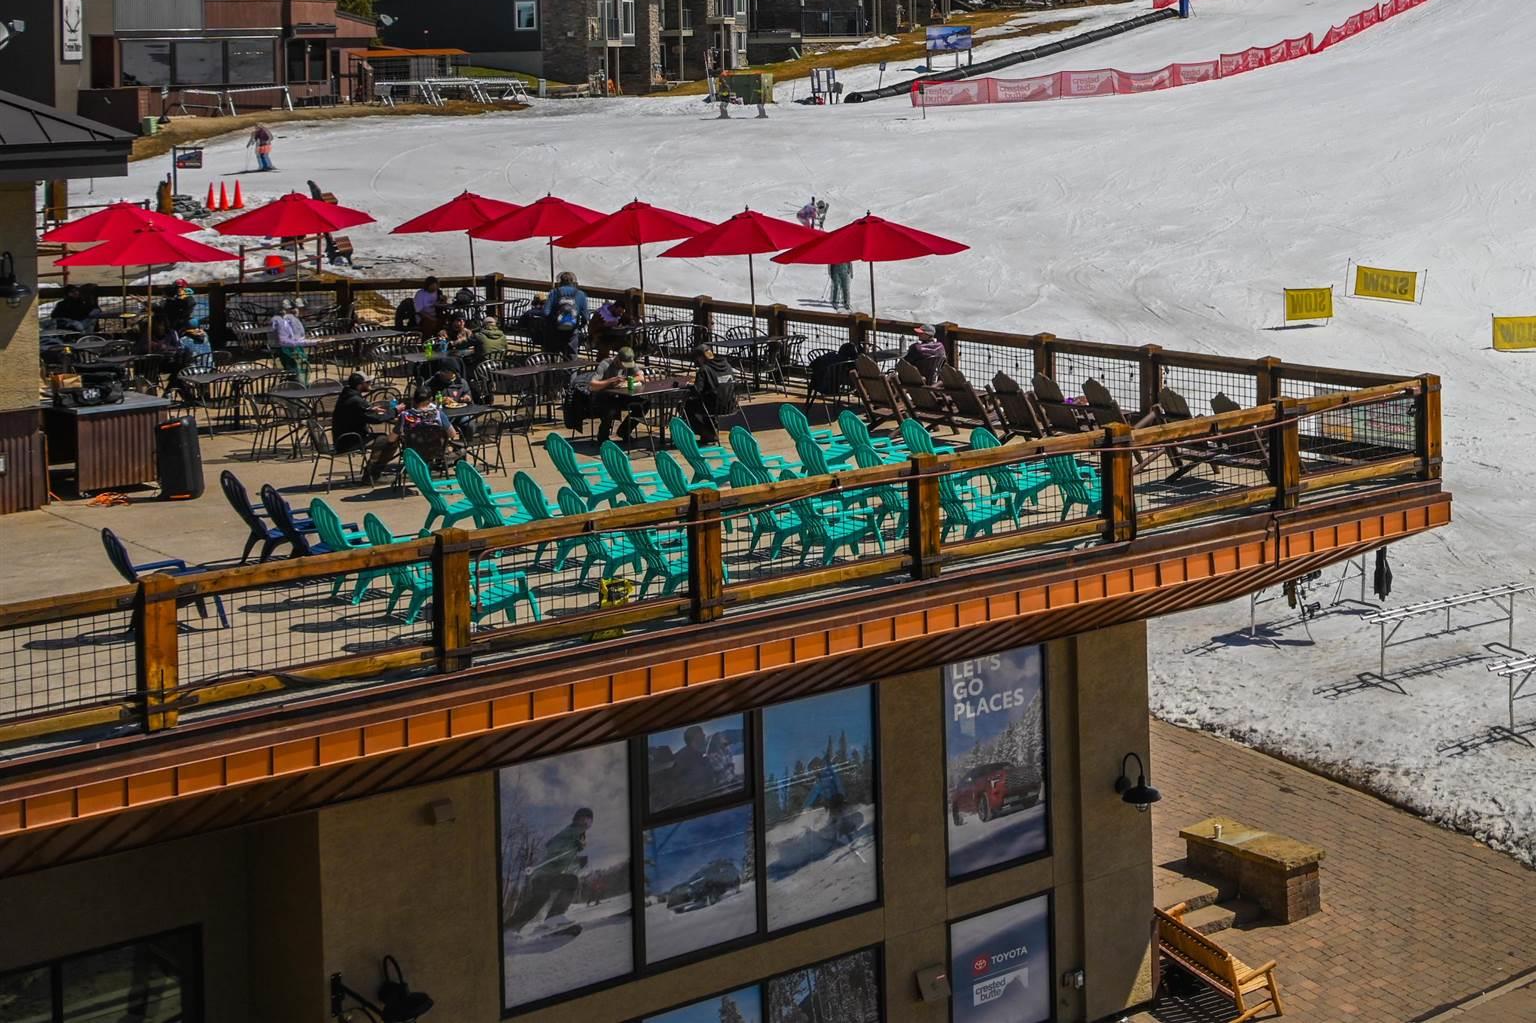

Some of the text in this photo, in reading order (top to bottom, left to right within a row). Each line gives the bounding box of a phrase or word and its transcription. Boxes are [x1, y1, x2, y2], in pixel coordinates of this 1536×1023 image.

[953, 653, 1001, 679] LET'S
[953, 678, 983, 700] GO
[954, 688, 1024, 721] PLACES
[991, 946, 1028, 965] TOYOTA
[975, 977, 1006, 995] crested
